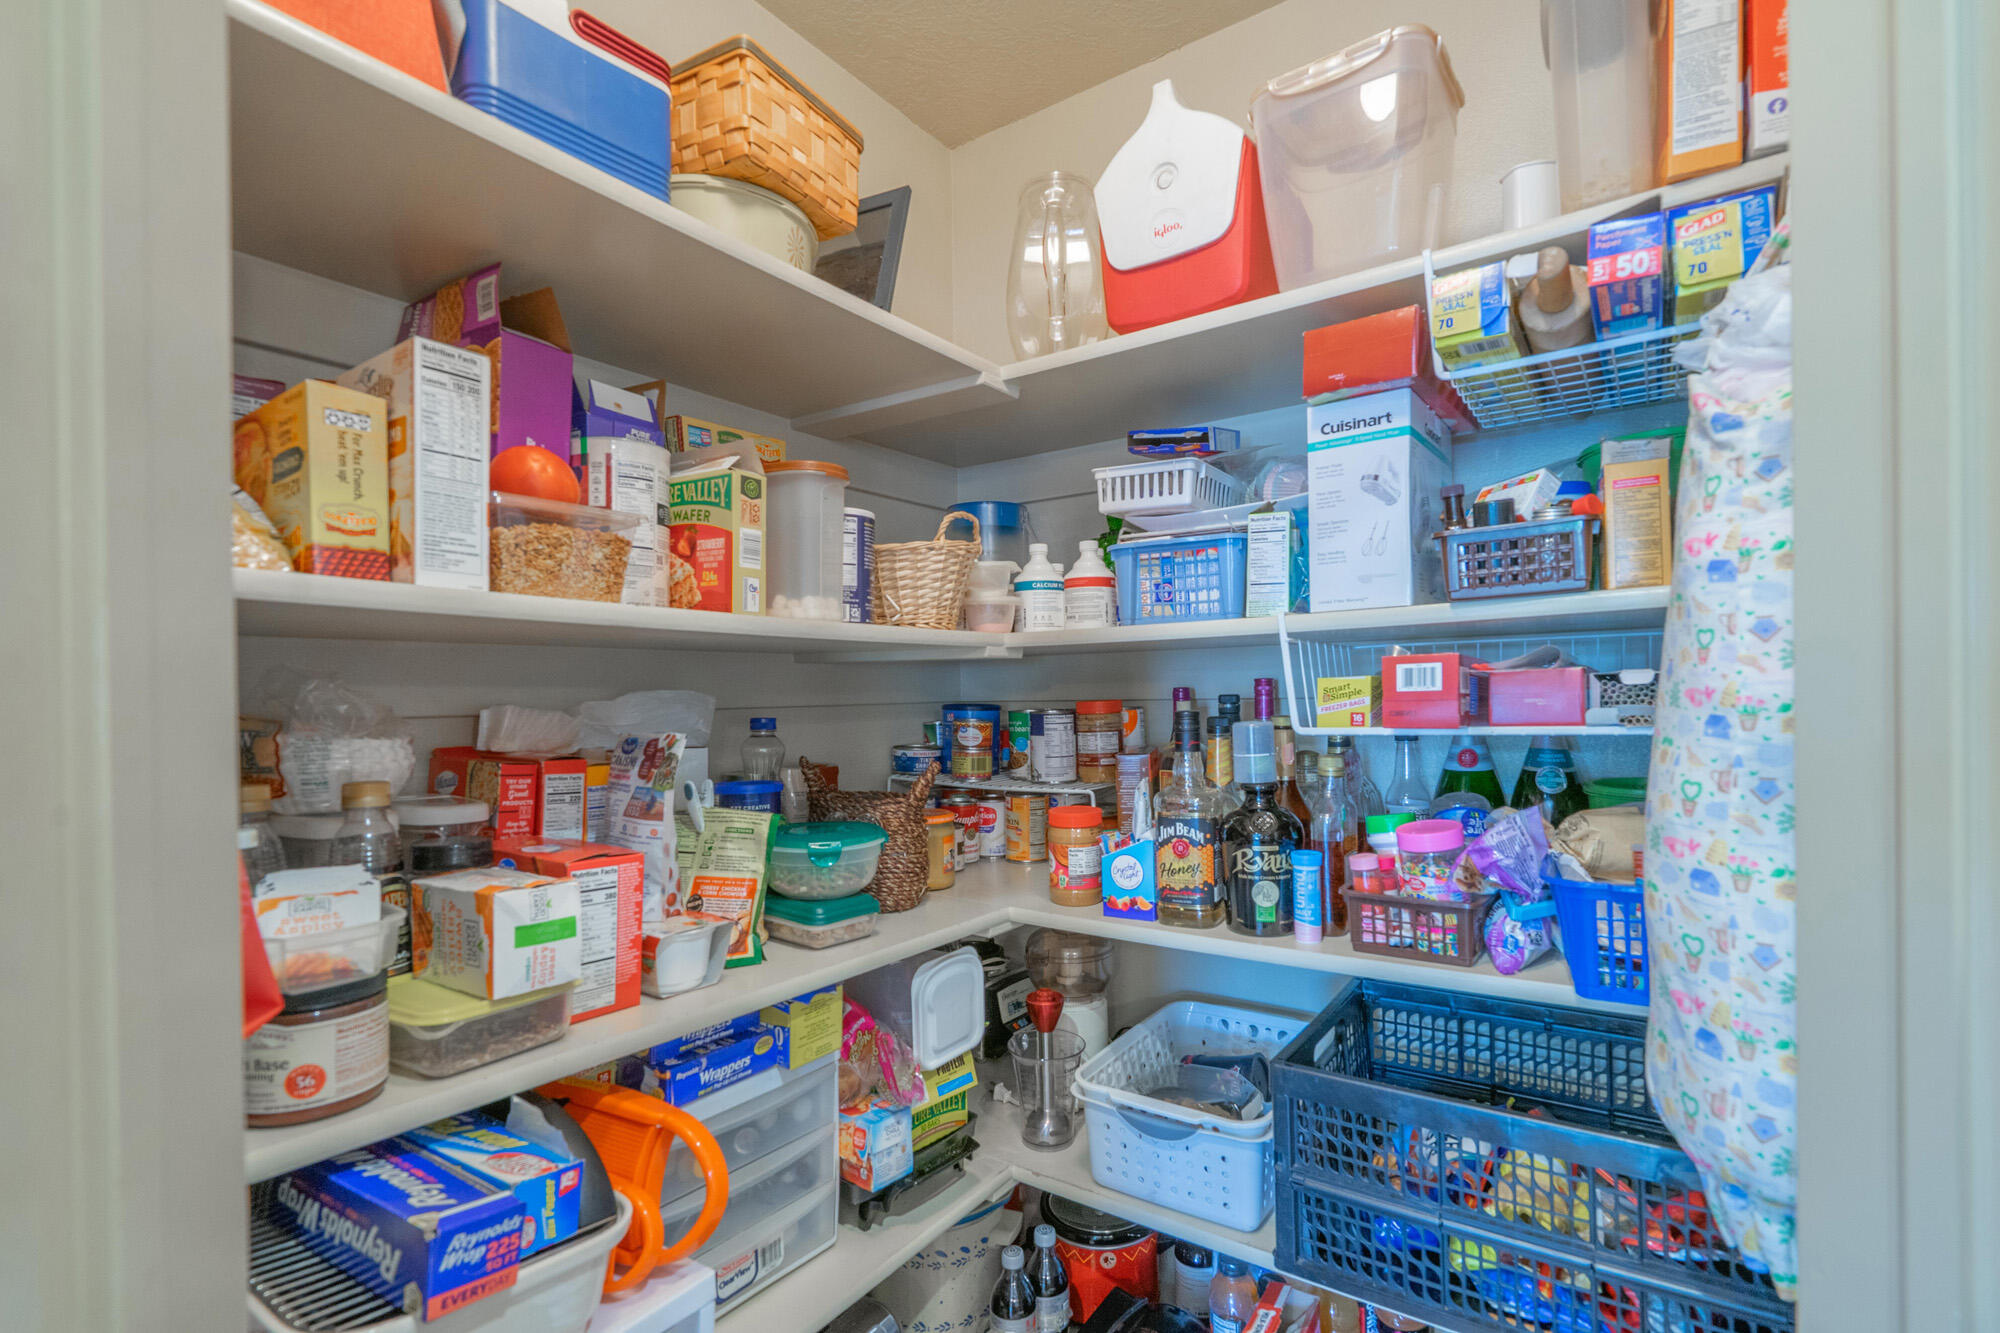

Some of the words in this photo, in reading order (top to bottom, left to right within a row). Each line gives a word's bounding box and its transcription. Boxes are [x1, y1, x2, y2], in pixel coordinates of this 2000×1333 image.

[1153, 222, 1183, 238] igloo
[1678, 211, 1725, 239] GLAD
[1615, 250, 1650, 278] 50
[1688, 261, 1707, 277] 70
[1439, 317, 1454, 330] 70
[1320, 411, 1393, 436] Cuisinart
[683, 476, 729, 508] VALLEY
[673, 509, 711, 523] WAFER
[1031, 581, 1058, 589] CALCIUM
[1322, 682, 1351, 696] Smart
[1330, 688, 1363, 701] Simple
[1320, 702, 1348, 713] FREEZER
[1349, 699, 1366, 708] BAGS
[1352, 713, 1363, 722] 16
[1158, 825, 1175, 843] JIM
[1175, 822, 1206, 845] BEAM
[571, 871, 600, 879] Nutrition
[600, 867, 618, 876] Facts
[1159, 861, 1201, 879] Honey
[699, 1055, 752, 1085] Wrappers
[295, 1074, 317, 1089] 56
[935, 1091, 967, 1113] VALLEY
[278, 1176, 321, 1233] Wrap
[446, 1214, 523, 1252] Reynolds
[319, 1206, 402, 1284] Reynolds
[438, 1244, 487, 1273] Wrap
[486, 1231, 522, 1260] 225
[504, 1250, 518, 1265] FT
[718, 1265, 751, 1290] ClearView
